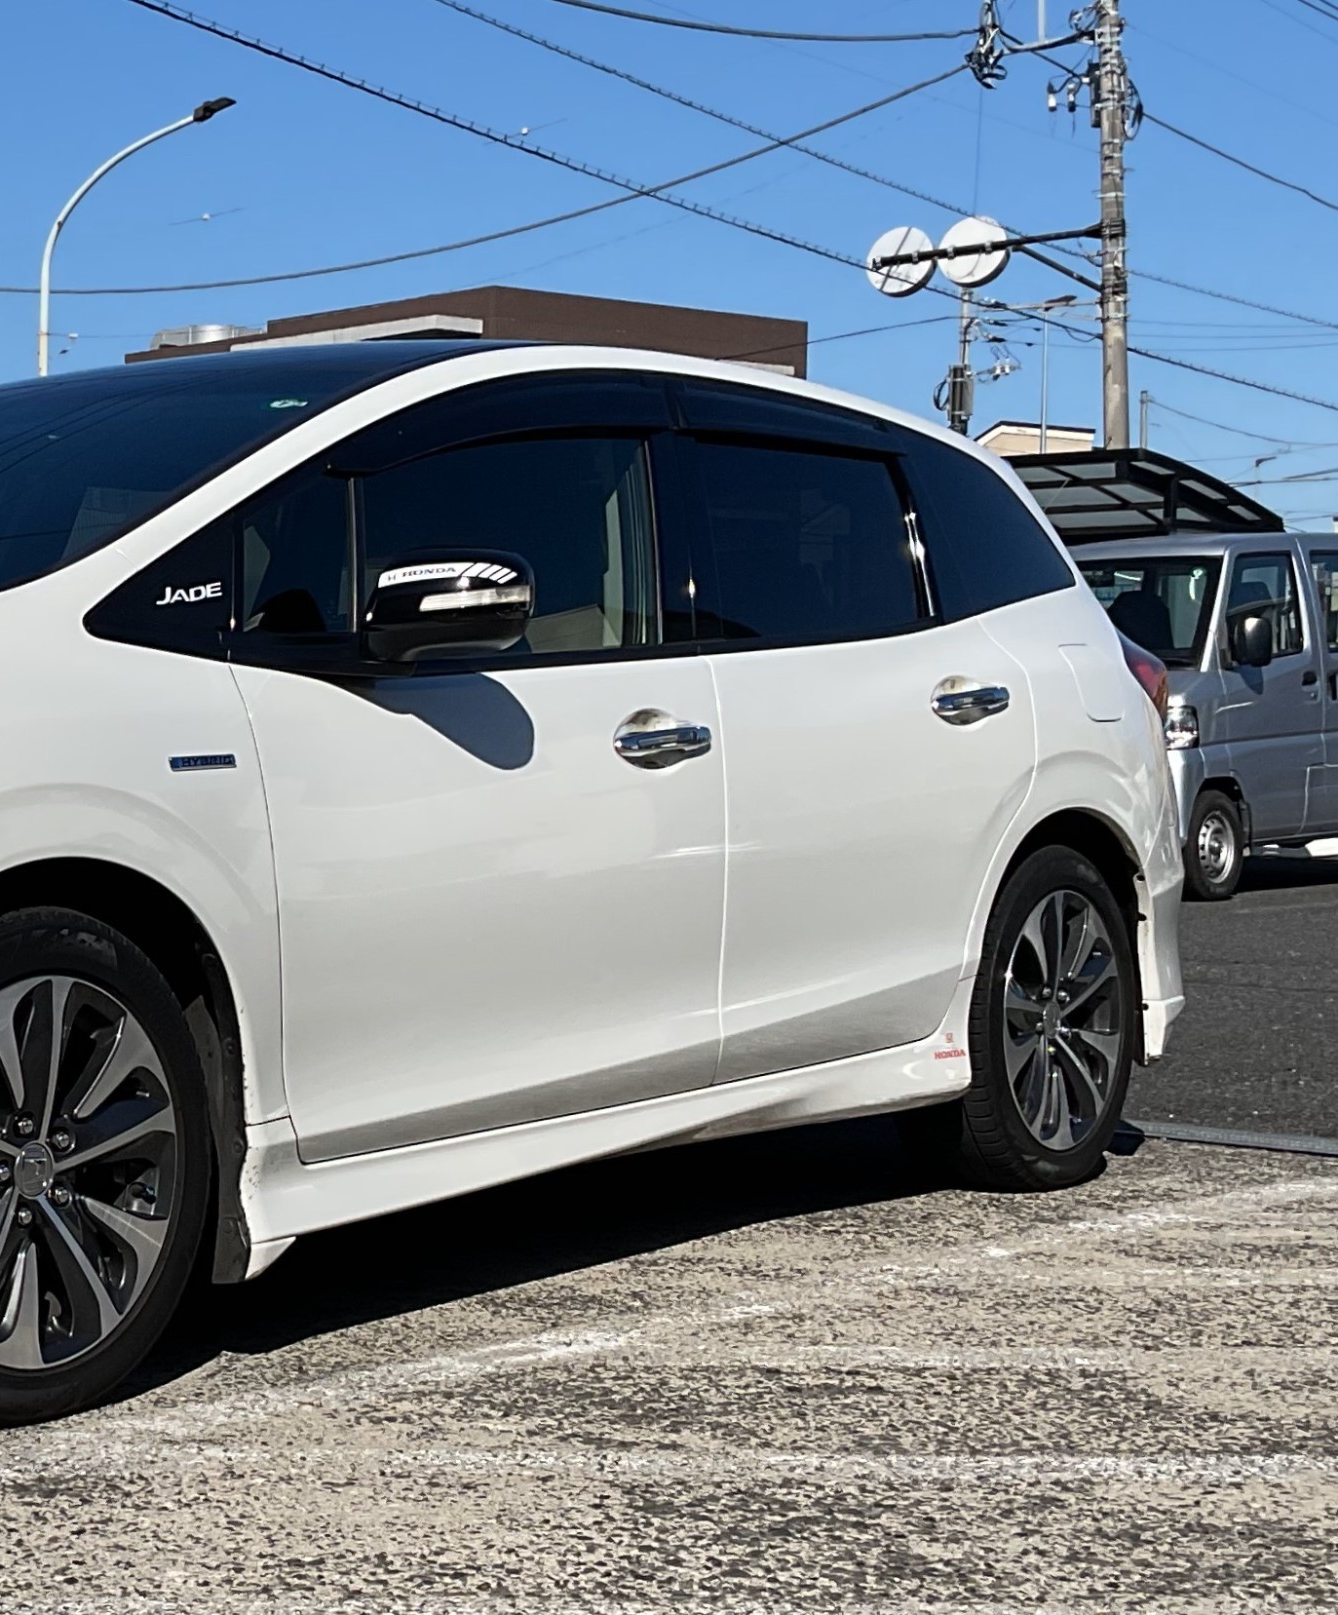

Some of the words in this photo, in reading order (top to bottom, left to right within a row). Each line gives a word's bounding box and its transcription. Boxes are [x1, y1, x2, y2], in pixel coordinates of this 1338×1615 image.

[401, 567, 457, 578] HONDA
[156, 581, 223, 605] JADE
[934, 1049, 966, 1060] HONDA
